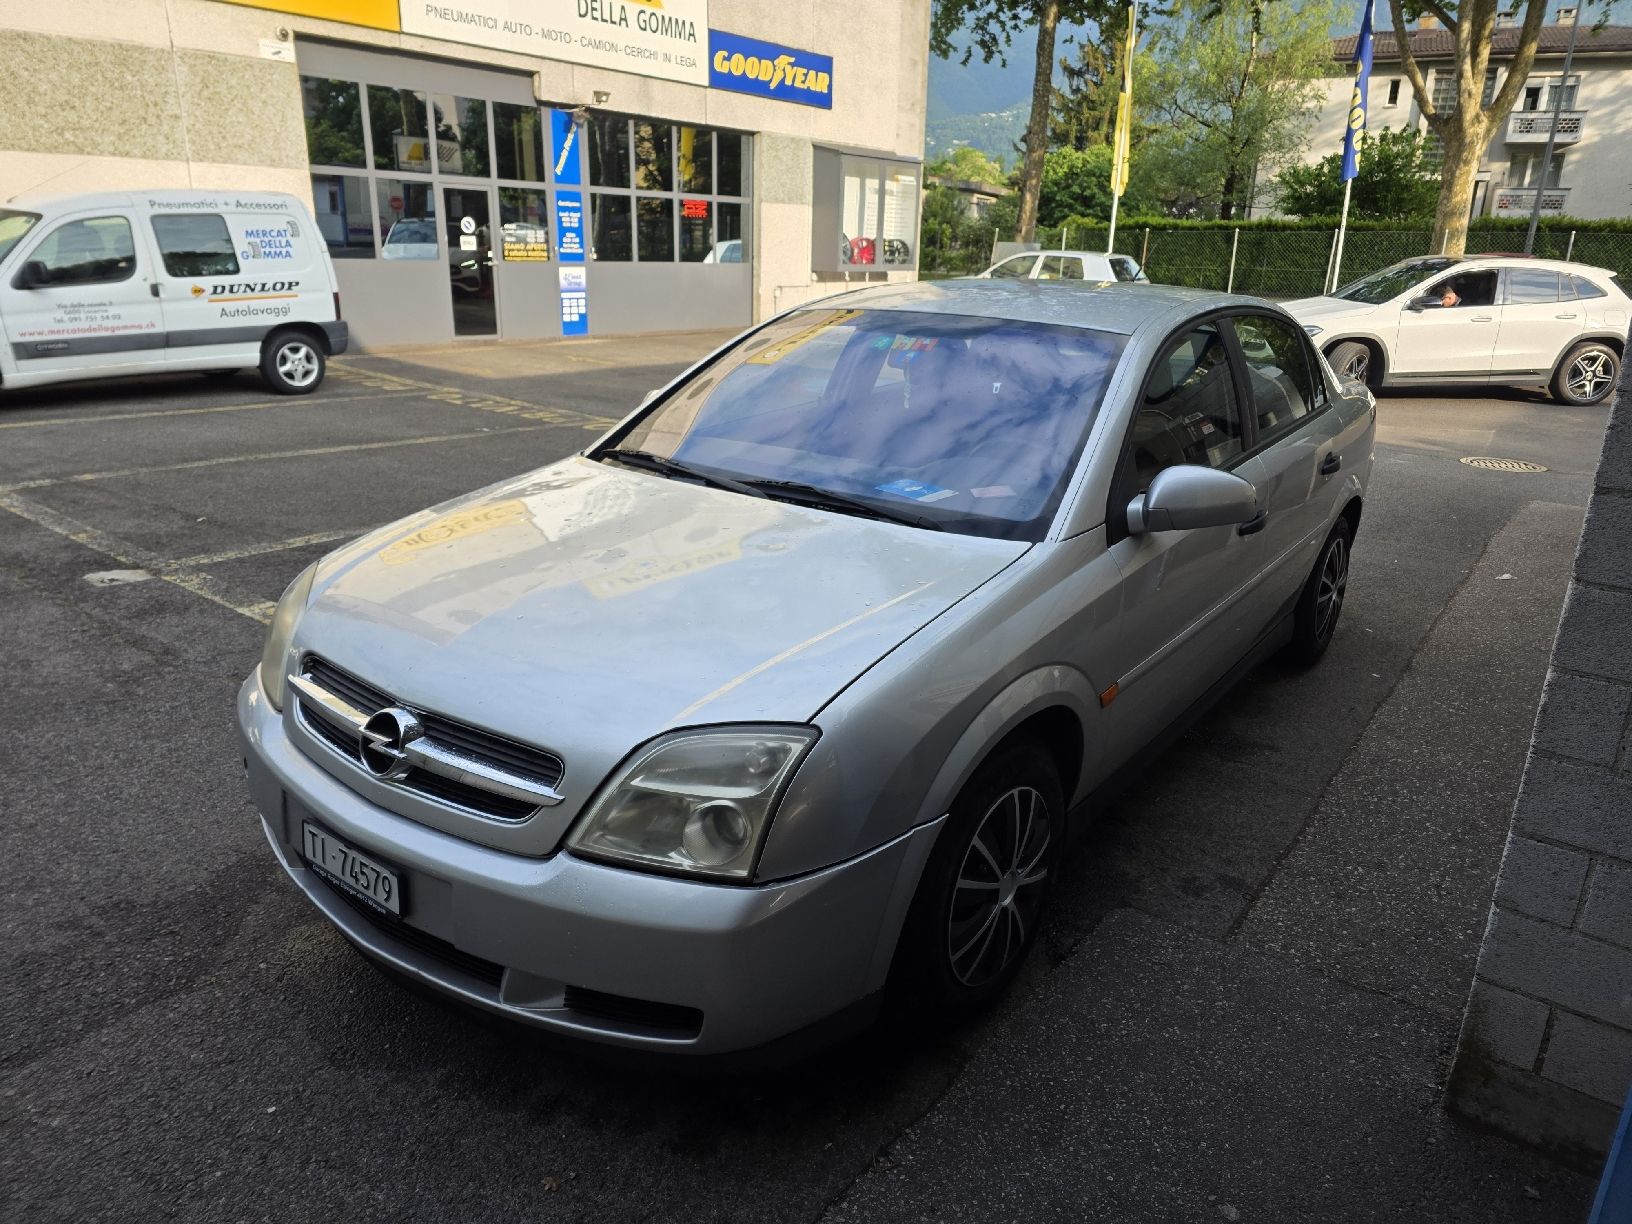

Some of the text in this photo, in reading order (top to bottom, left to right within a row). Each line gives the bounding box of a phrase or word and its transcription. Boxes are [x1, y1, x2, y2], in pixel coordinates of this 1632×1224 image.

[577, 0, 697, 43] DELLA GOMMA
[425, 4, 498, 30] PNEUMATICI
[503, 20, 533, 37] AUTO
[541, 28, 572, 44] MOTO
[624, 45, 658, 60] CERCHI
[663, 52, 671, 64] IN
[675, 54, 697, 69] LEGA
[713, 50, 830, 94] GOODYEAR
[148, 199, 218, 210] Pneumatici
[235, 200, 289, 211] Accessori
[260, 239, 292, 249] DELLA
[210, 281, 300, 295] DUNLOP
[220, 303, 291, 318] Autolavaggi
[18, 320, 156, 338] www.mercatodellagomma.ch
